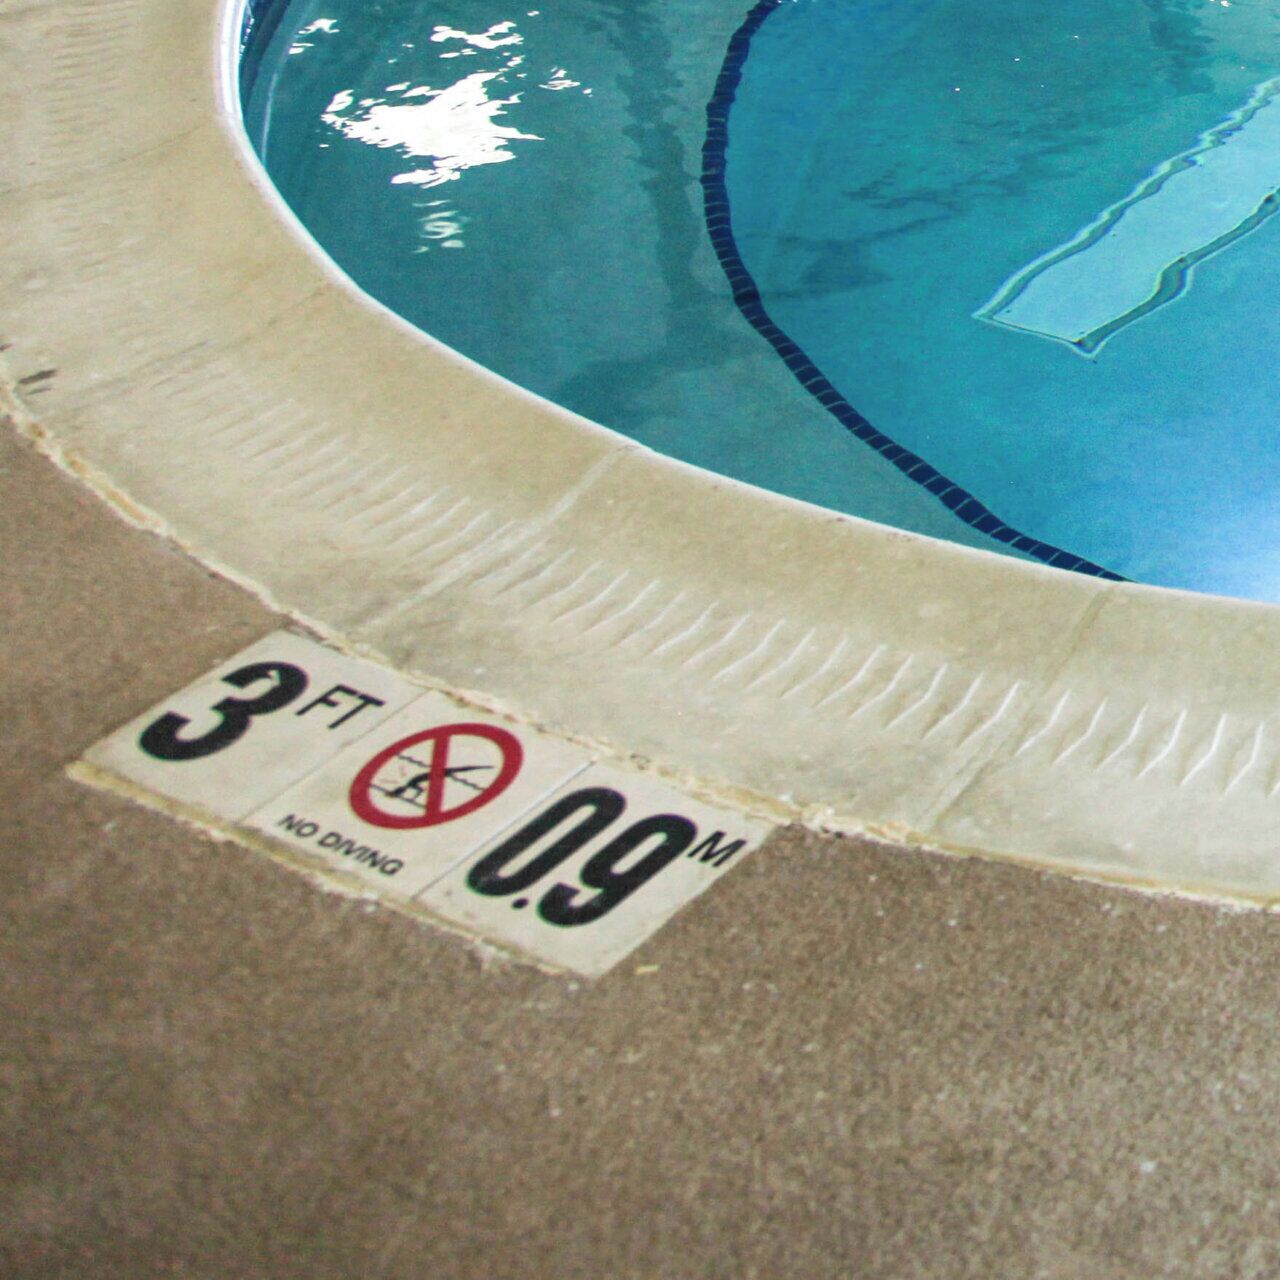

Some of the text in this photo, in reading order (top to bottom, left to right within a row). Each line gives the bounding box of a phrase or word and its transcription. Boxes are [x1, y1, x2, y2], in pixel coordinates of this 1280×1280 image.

[139, 661, 748, 928] 3 FT 0.9 M
[278, 813, 404, 876] NO DIVING
